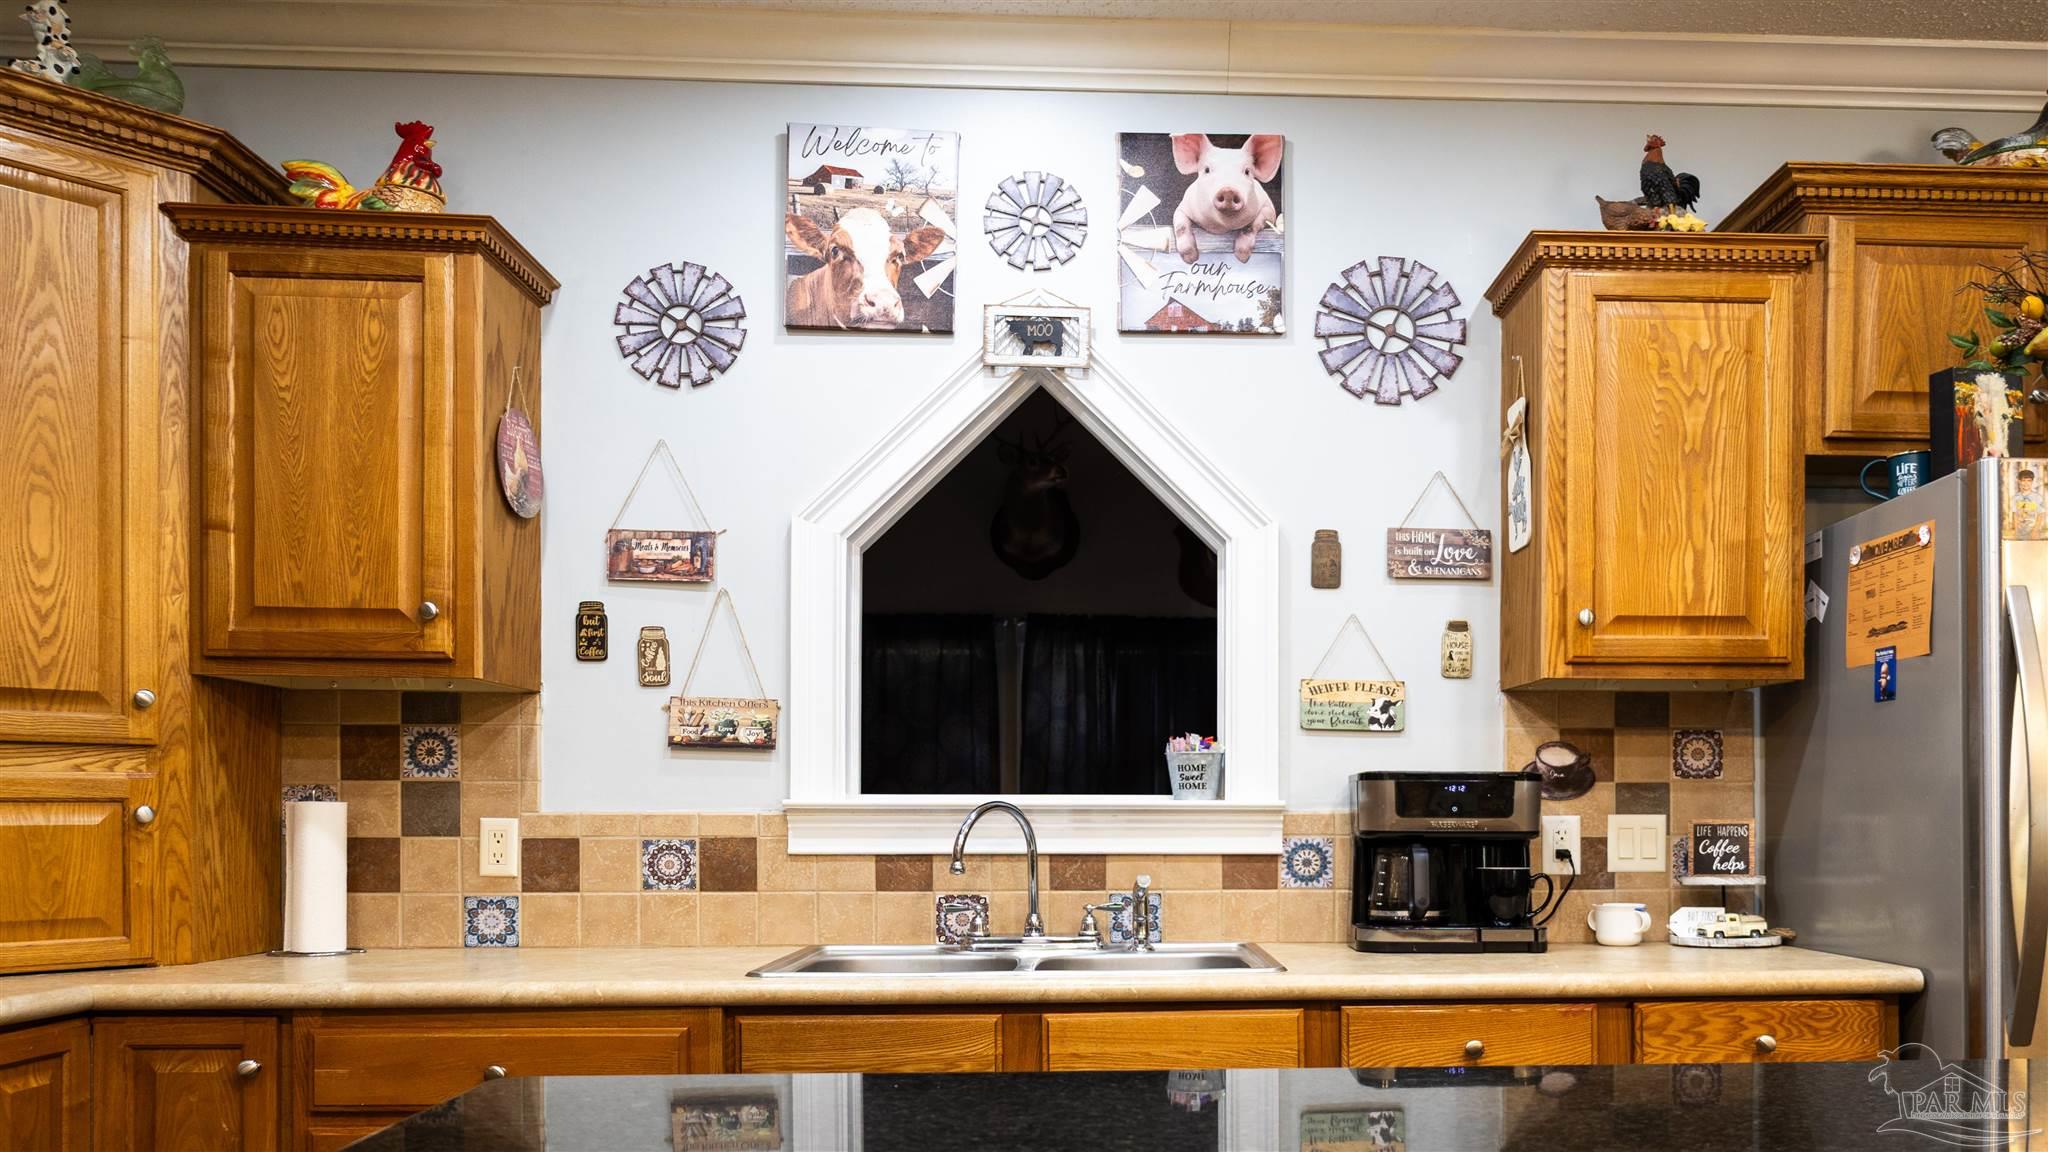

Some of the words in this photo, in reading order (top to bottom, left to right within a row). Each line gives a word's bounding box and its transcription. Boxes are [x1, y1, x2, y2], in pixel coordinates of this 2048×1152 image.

[801, 125, 914, 159] Welcome
[912, 133, 943, 167] to
[1190, 261, 1231, 276] our
[1159, 271, 1269, 300] Farmhouse
[1027, 323, 1054, 337] MOO
[1896, 462, 1918, 476] LIFE
[1395, 531, 1410, 542] THIS
[1411, 531, 1436, 544] HOME
[635, 541, 653, 552] Meals
[1394, 547, 1402, 555] is
[1403, 546, 1423, 556] built
[1430, 533, 1478, 565] Love
[1407, 559, 1423, 576] &
[1424, 565, 1482, 576] SHENANIGANS
[583, 615, 600, 626] but
[579, 646, 604, 657] Coffee
[1308, 682, 1350, 696] HEIFER
[1354, 682, 1400, 697] PLEASE
[698, 698, 736, 708] Kitchen
[737, 700, 769, 709] Offers
[746, 729, 760, 737] Joy
[1177, 764, 1207, 772] HOME
[1179, 773, 1206, 781] Sweet
[1178, 782, 1208, 790] HOME
[1696, 825, 1712, 837] LIFE
[1717, 825, 1749, 837] HAPPENS
[1699, 839, 1740, 857] Coffee
[1712, 856, 1747, 873] helps
